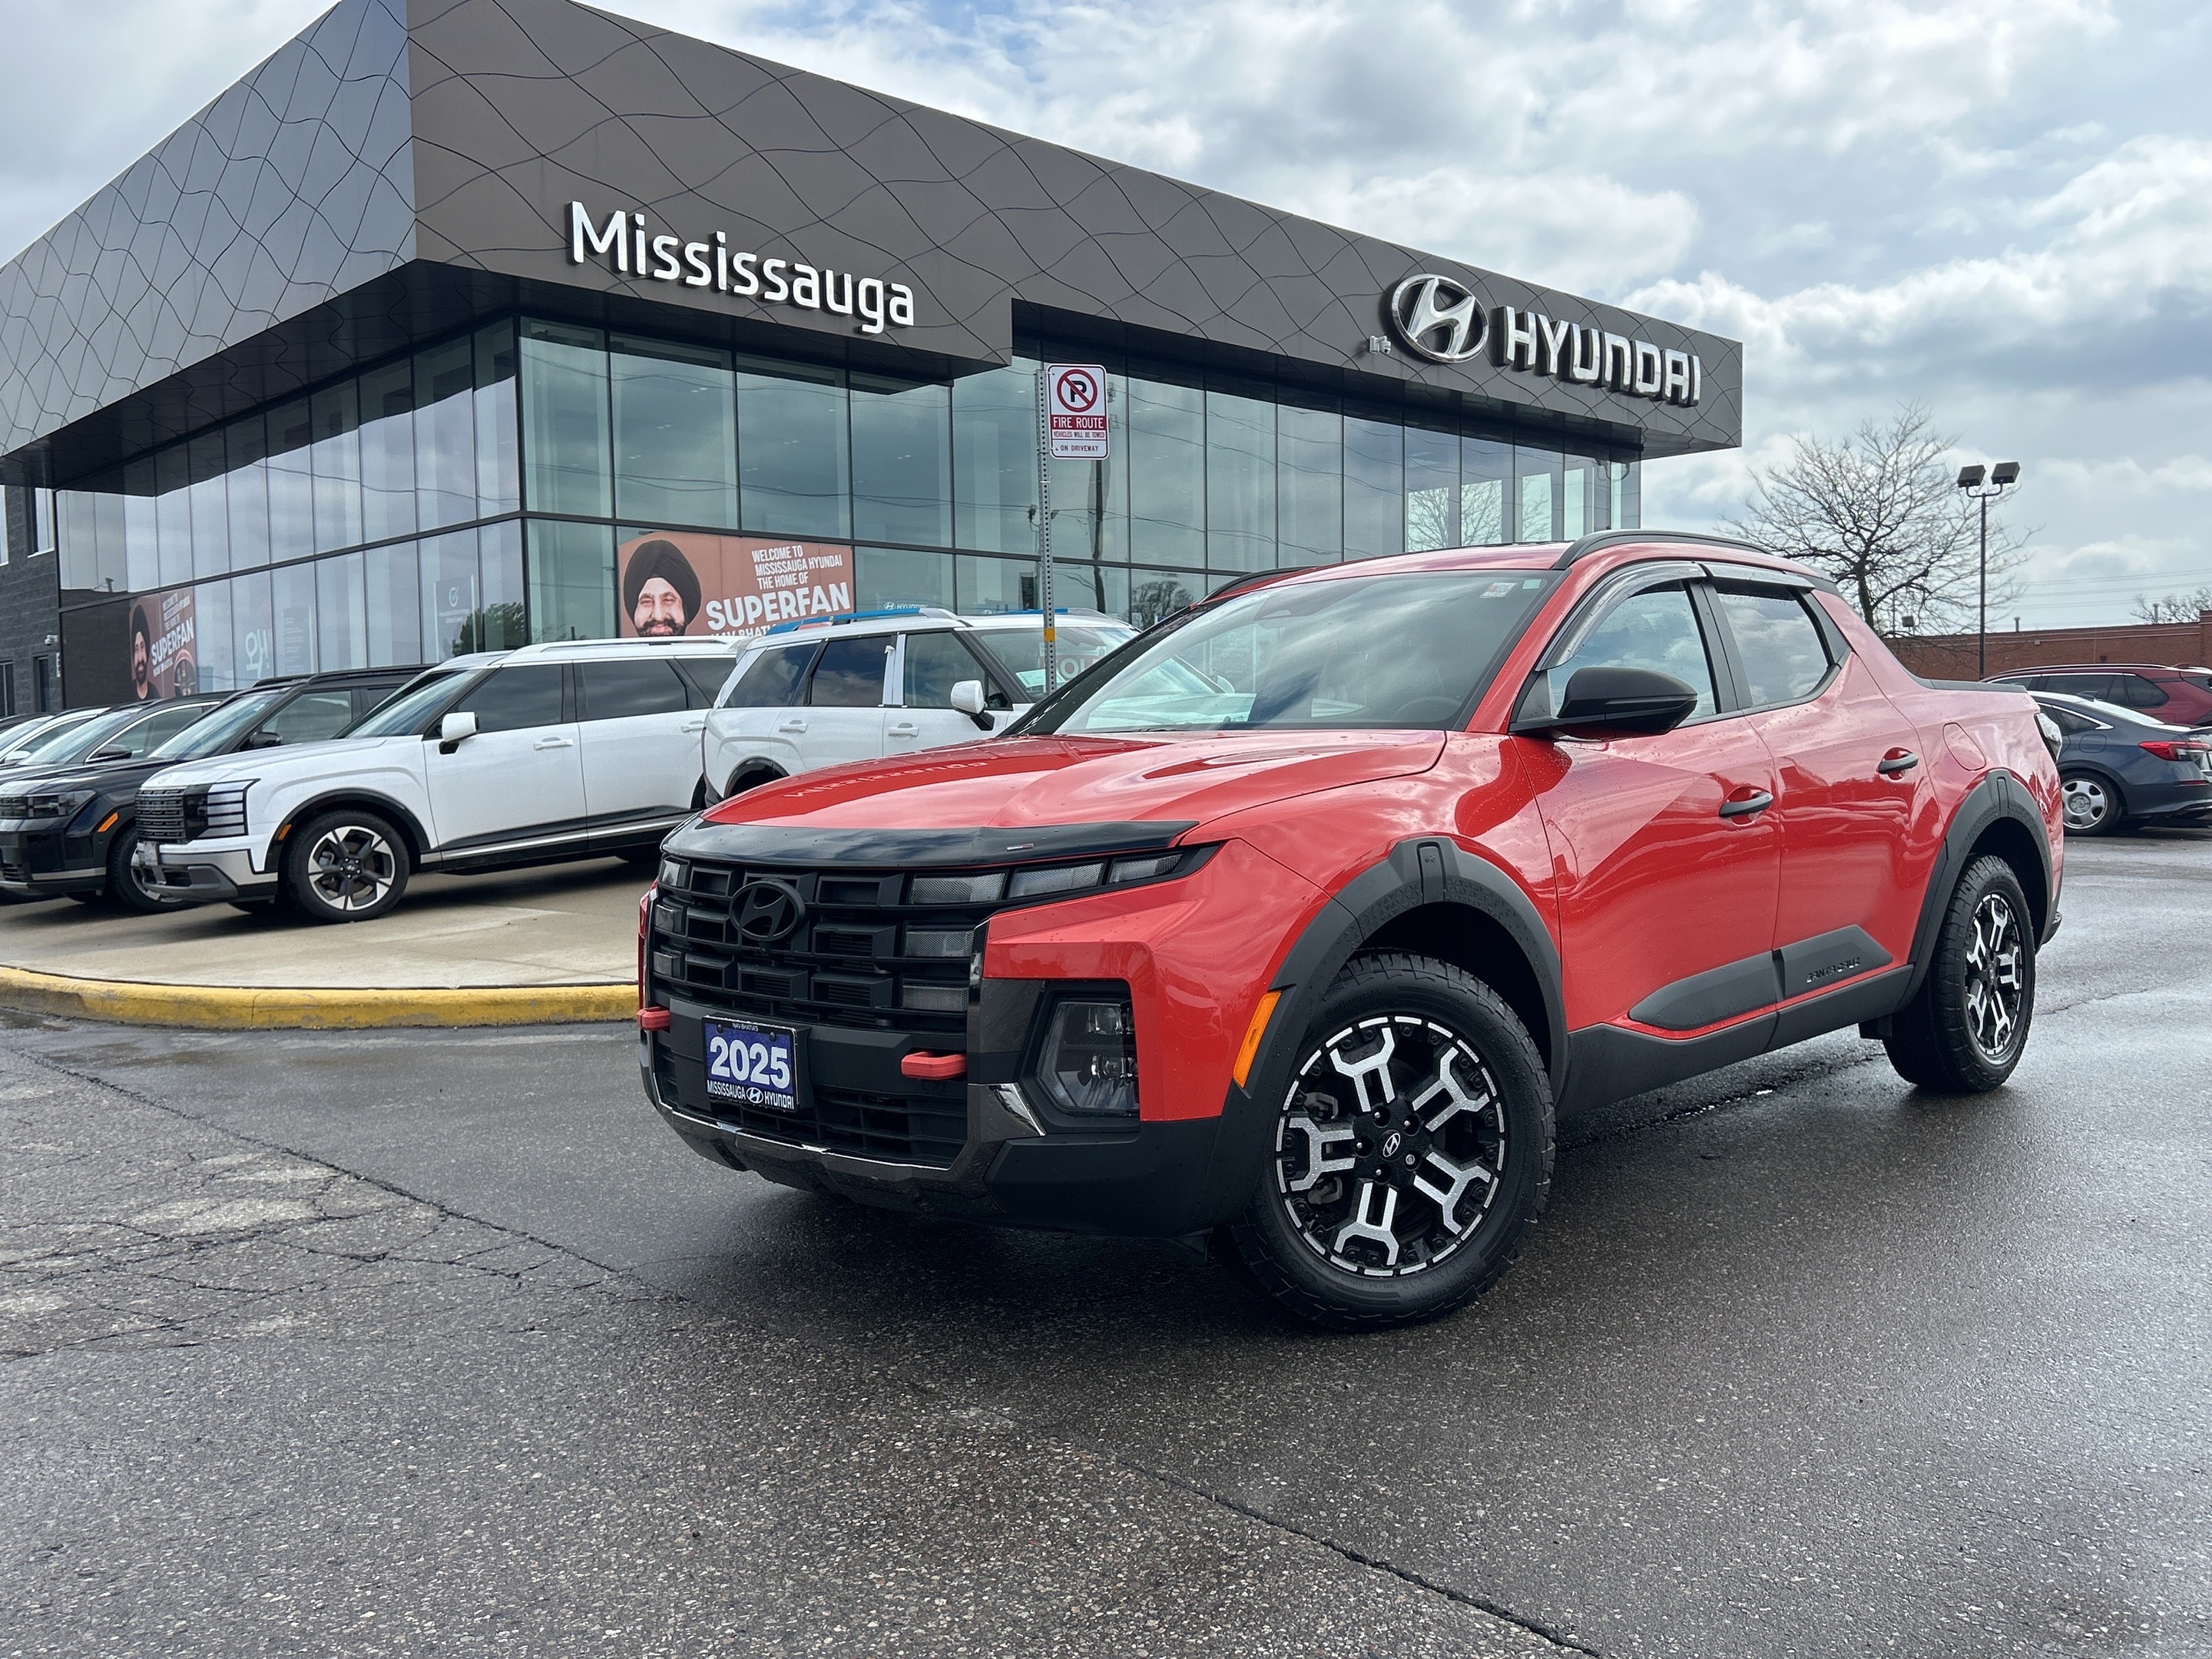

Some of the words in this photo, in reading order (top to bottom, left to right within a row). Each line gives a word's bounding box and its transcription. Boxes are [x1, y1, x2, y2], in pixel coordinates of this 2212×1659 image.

[570, 200, 915, 335] Mississauga
[1501, 305, 1702, 407] HYUNDAI
[1053, 416, 1072, 428] FIRE
[1076, 417, 1104, 429] ROUTE
[752, 546, 791, 562] WELCOME
[791, 545, 803, 558] TO
[755, 558, 808, 577] MISSISSAUGA
[808, 554, 843, 570] HYUNDAI
[757, 575, 774, 590] THE
[774, 572, 798, 588] HOME
[799, 571, 809, 584] OF
[706, 581, 851, 631] SUPERFAN
[151, 617, 194, 665] SUPERFAN
[710, 1036, 790, 1089] 2025
[707, 1080, 746, 1101] MISSISSAUGA
[764, 1091, 794, 1110] HYUNDAI
